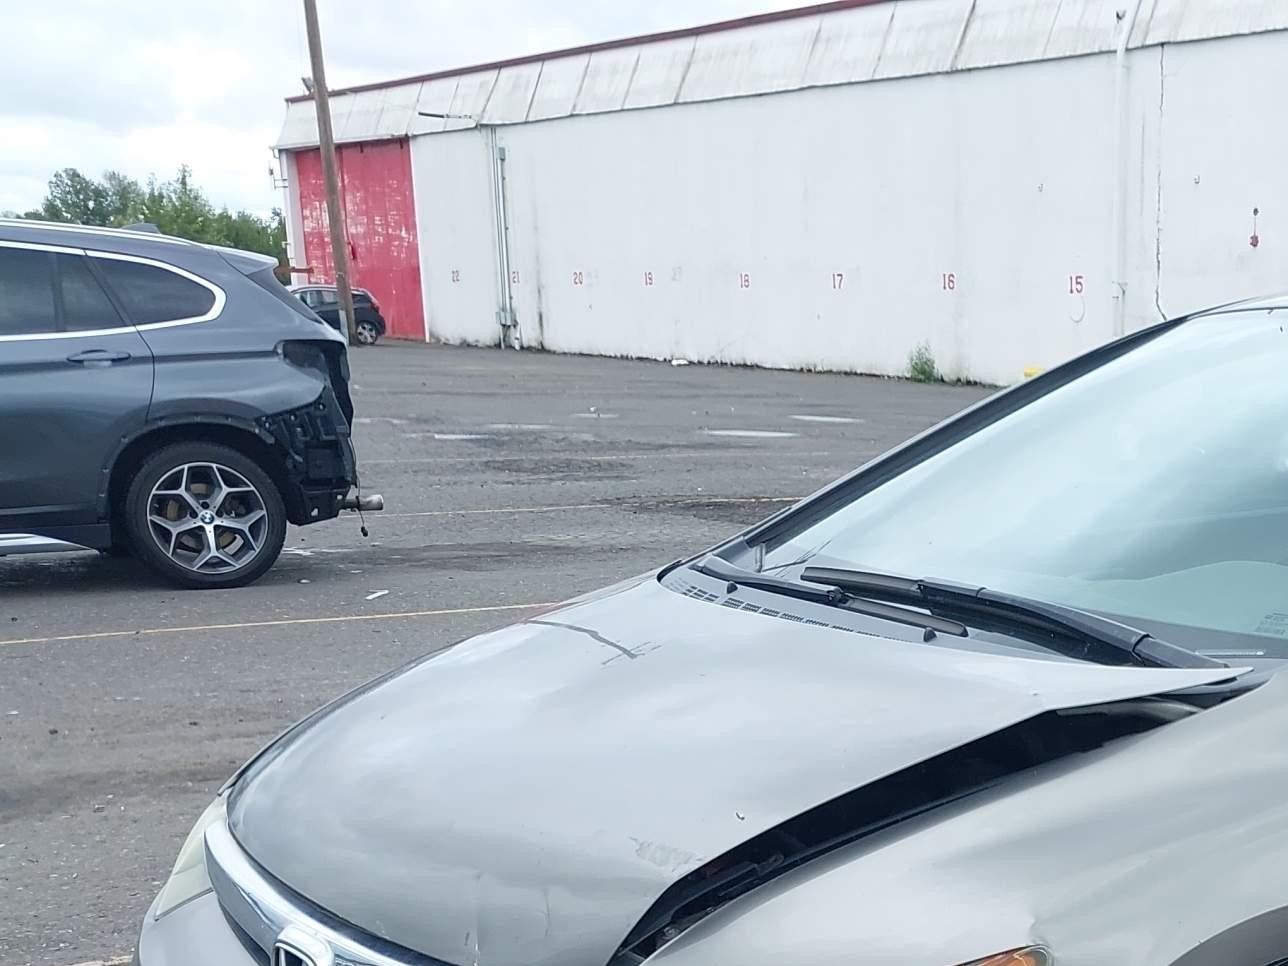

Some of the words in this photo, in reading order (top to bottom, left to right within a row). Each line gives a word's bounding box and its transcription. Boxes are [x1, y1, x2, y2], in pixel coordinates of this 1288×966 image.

[572, 271, 584, 286] 20
[644, 271, 654, 287] 19
[739, 272, 751, 289] 18
[831, 273, 844, 290] 17
[942, 273, 956, 291] 16
[1068, 275, 1084, 295] 15
